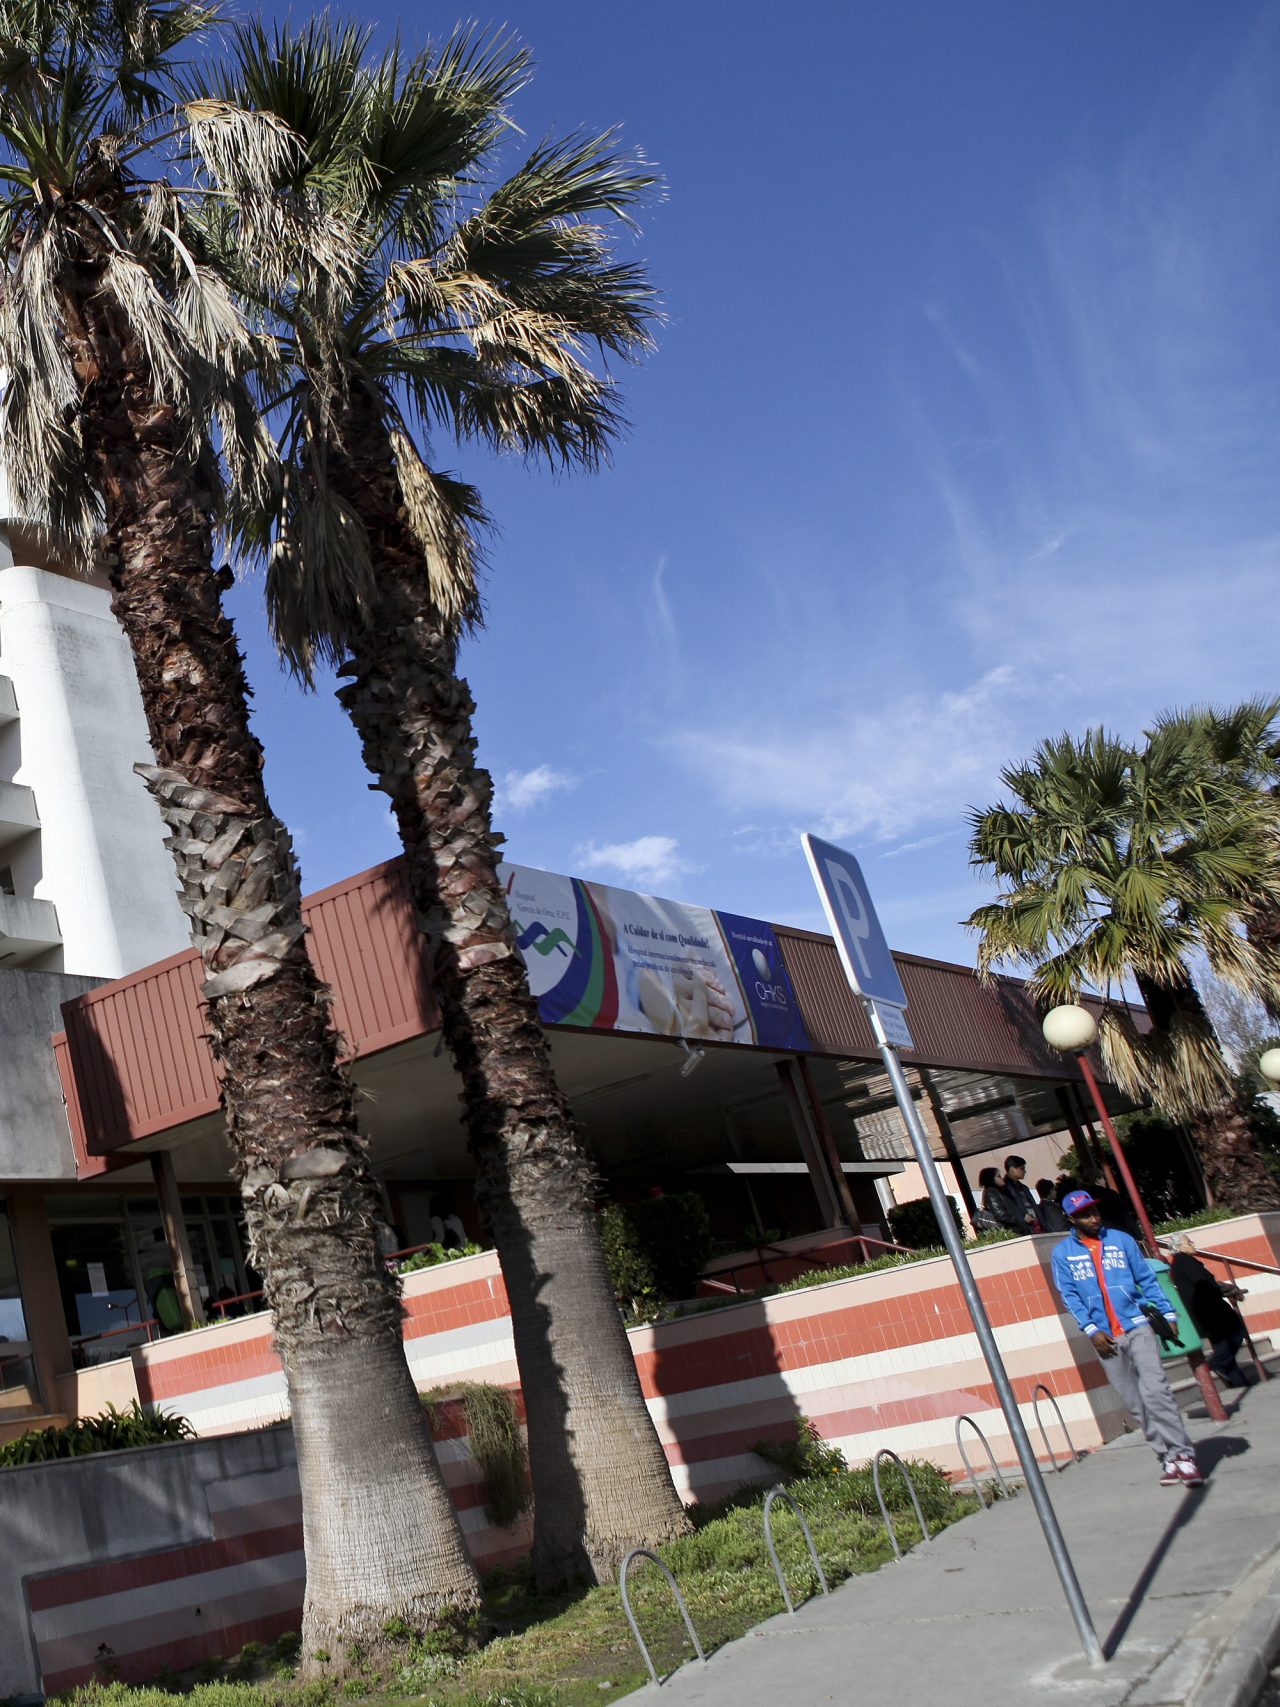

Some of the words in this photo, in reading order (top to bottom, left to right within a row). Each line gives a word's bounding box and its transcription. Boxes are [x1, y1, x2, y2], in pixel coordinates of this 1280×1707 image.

[824, 858, 872, 979] P
[624, 922, 629, 934] A
[628, 924, 650, 938] Cuidar
[651, 928, 659, 940] de
[665, 934, 678, 943] com
[678, 933, 710, 949] Qualidade!
[755, 981, 787, 1004] CHKS
